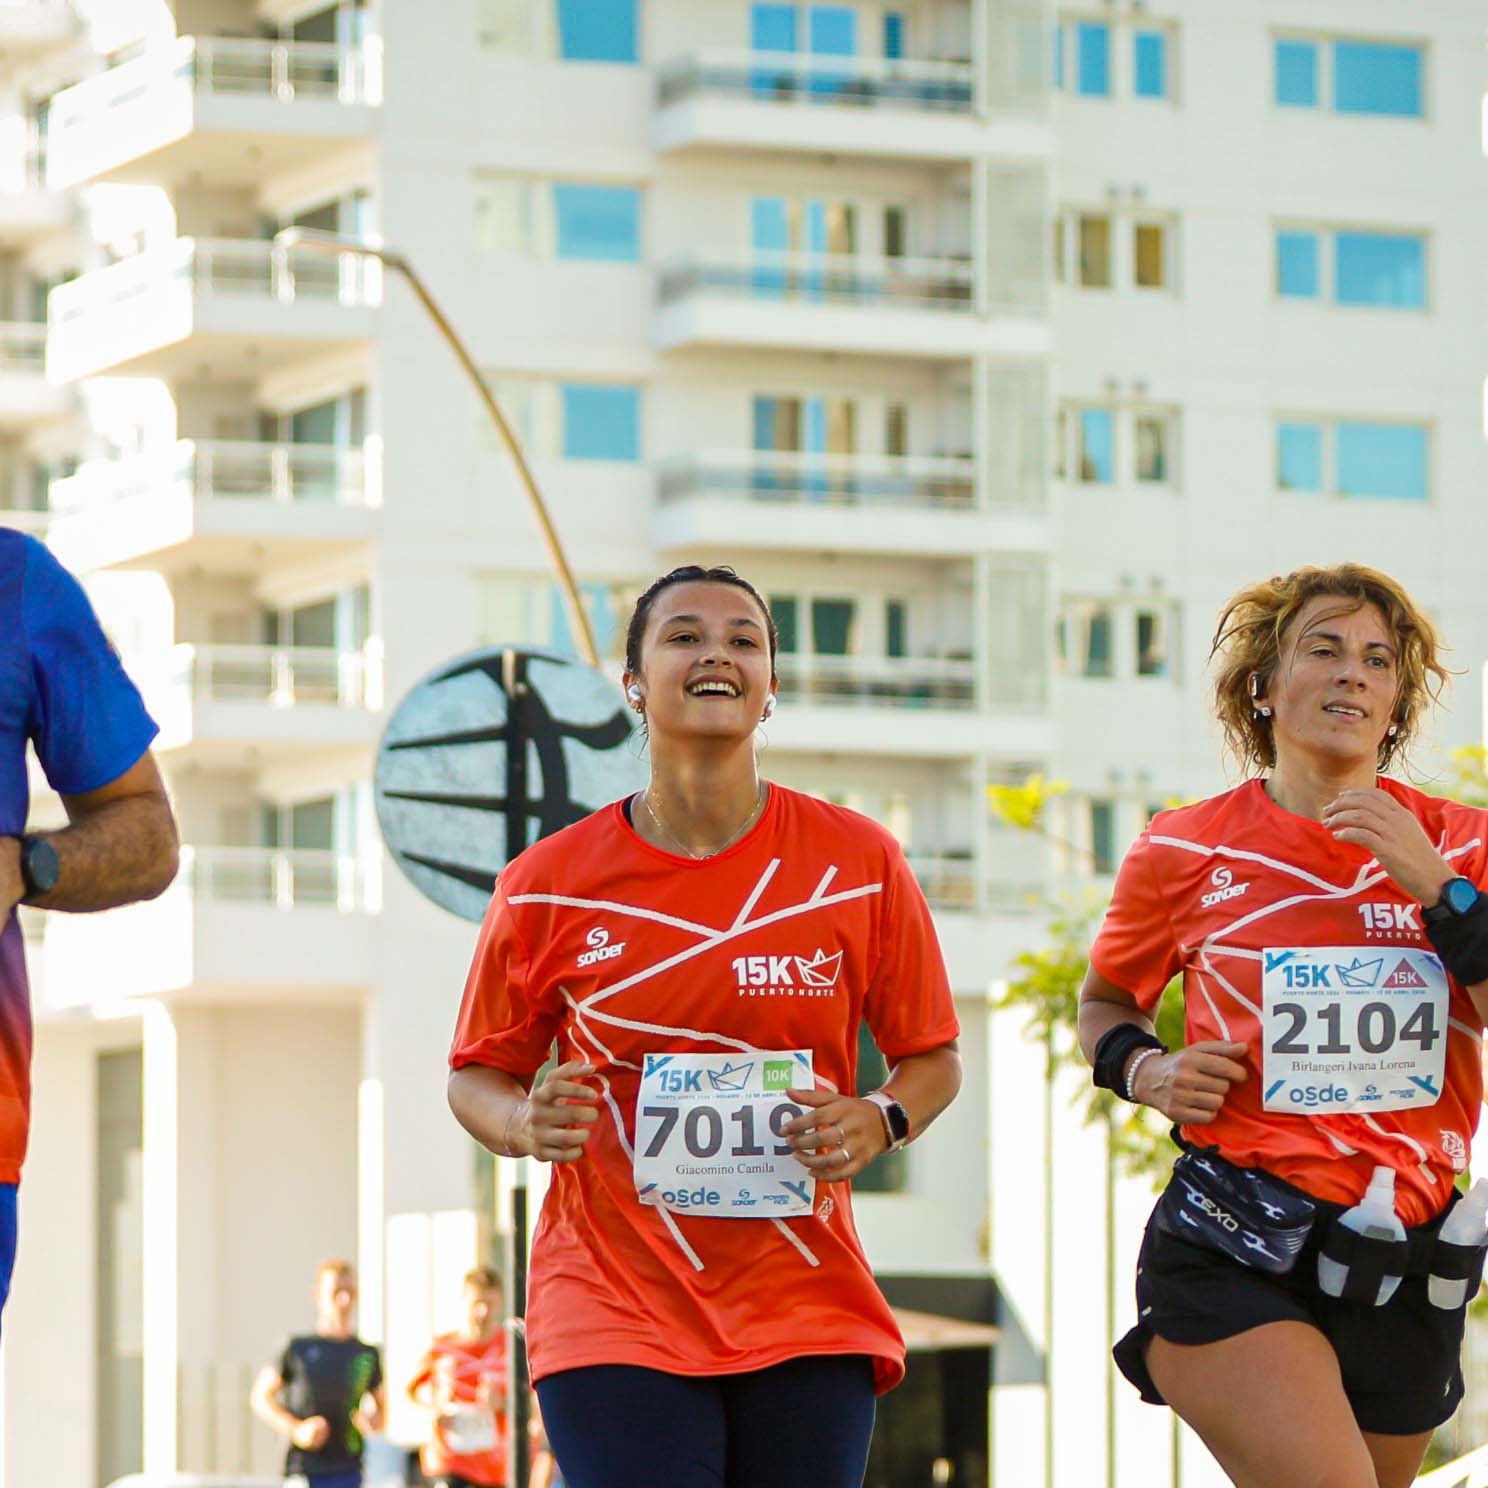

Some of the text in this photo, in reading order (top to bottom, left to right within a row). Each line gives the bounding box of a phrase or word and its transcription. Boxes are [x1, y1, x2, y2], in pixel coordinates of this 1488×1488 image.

[1358, 902, 1420, 931] 15K
[1365, 930, 1422, 941] PUERTO
[732, 955, 794, 986] 15K
[1282, 963, 1332, 989] 15K
[1393, 971, 1418, 985] 15K
[1271, 1001, 1441, 1055] 2104
[766, 1069, 791, 1082] 10K
[1379, 1059, 1417, 1071] Lorena
[658, 1069, 704, 1093] 15K
[1289, 1083, 1349, 1108] osde
[643, 1103, 804, 1158] 7019
[675, 1163, 775, 1176] Giacomino Camila
[662, 1187, 721, 1208] osde
